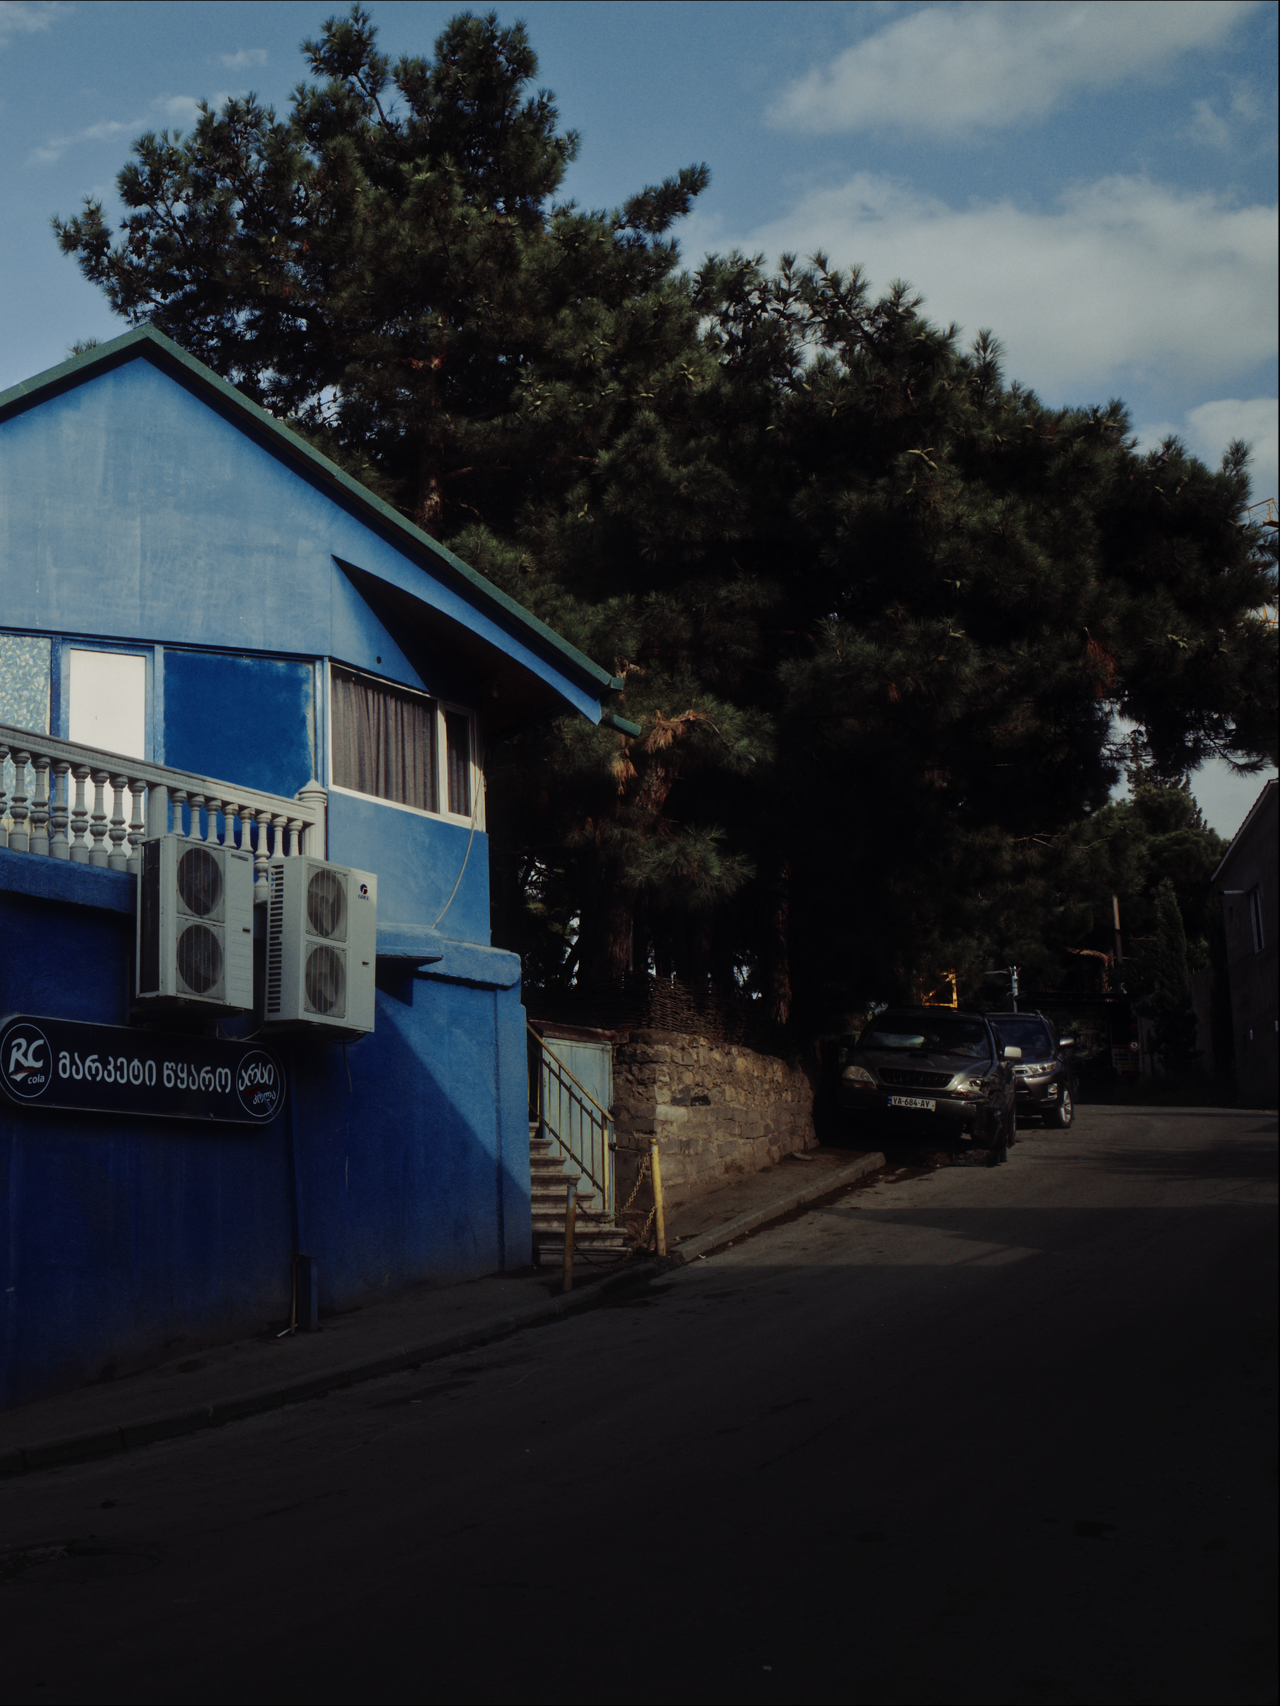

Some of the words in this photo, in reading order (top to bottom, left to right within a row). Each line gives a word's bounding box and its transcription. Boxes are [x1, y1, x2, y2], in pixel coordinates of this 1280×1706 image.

[8, 1037, 45, 1074] RC
[27, 1073, 45, 1085] cola
[58, 1050, 157, 1086] მარკეტი
[163, 1061, 232, 1093] წყარო
[238, 1062, 274, 1091] არსი
[252, 1090, 277, 1105] კოლა
